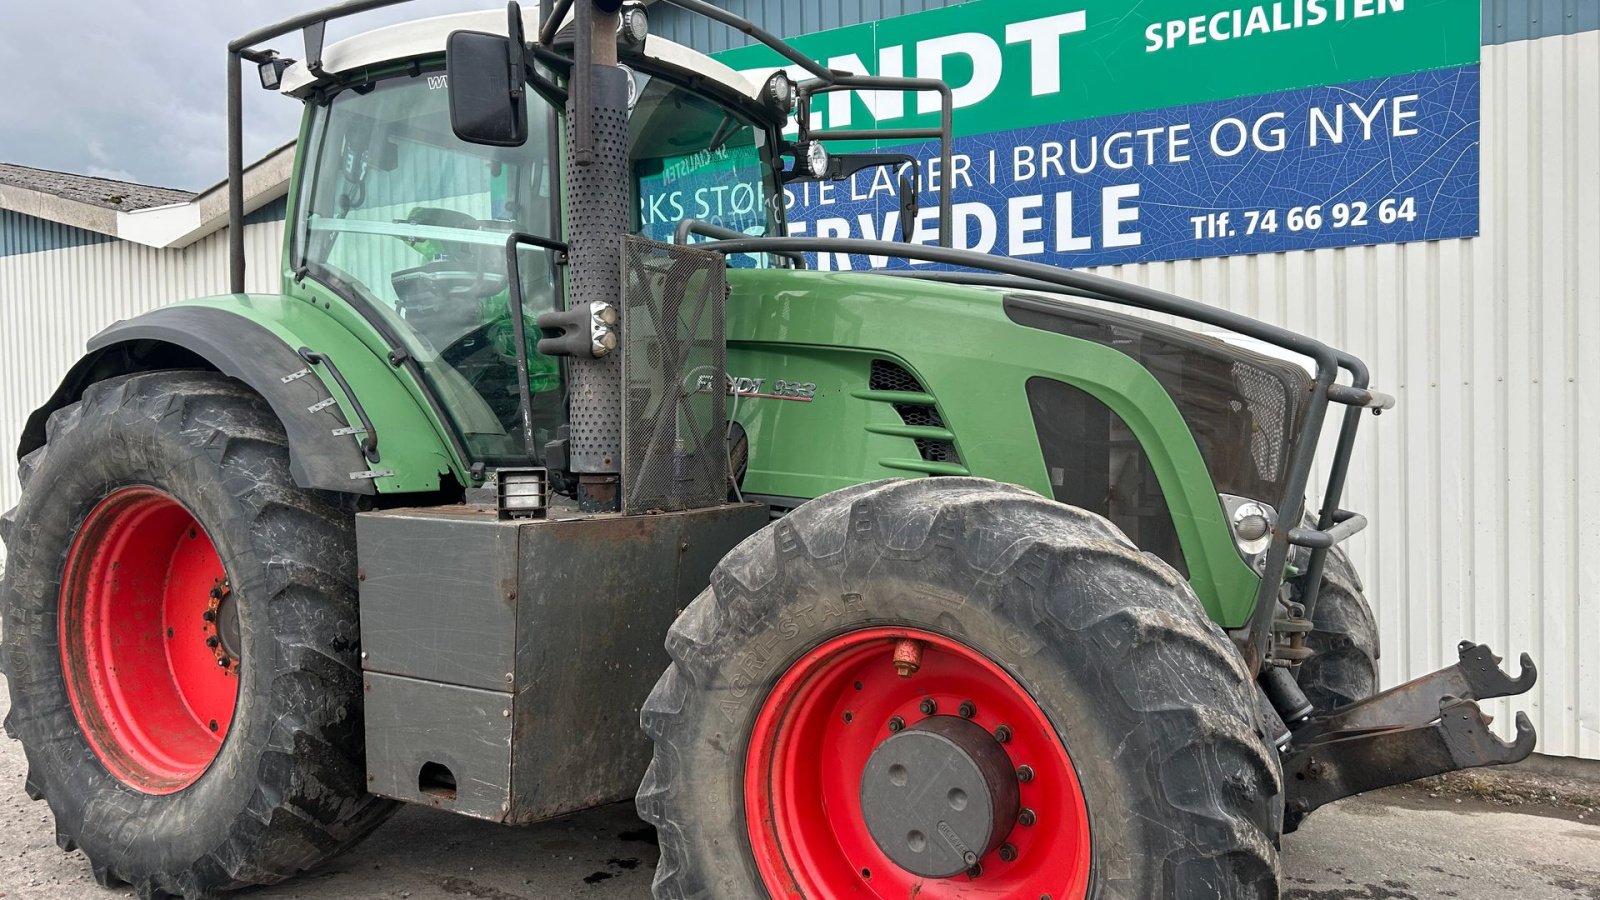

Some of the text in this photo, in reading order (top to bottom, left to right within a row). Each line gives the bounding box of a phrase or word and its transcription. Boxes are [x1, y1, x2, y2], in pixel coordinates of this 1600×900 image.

[850, 154, 973, 201] LAGER
[988, 149, 996, 185] I
[1013, 123, 1192, 182] BRUGTE
[1210, 112, 1286, 157] OG
[1309, 94, 1419, 147] NYE
[1190, 197, 1417, 240] Tlf. 74 66 92 64
[774, 379, 817, 398] 933
